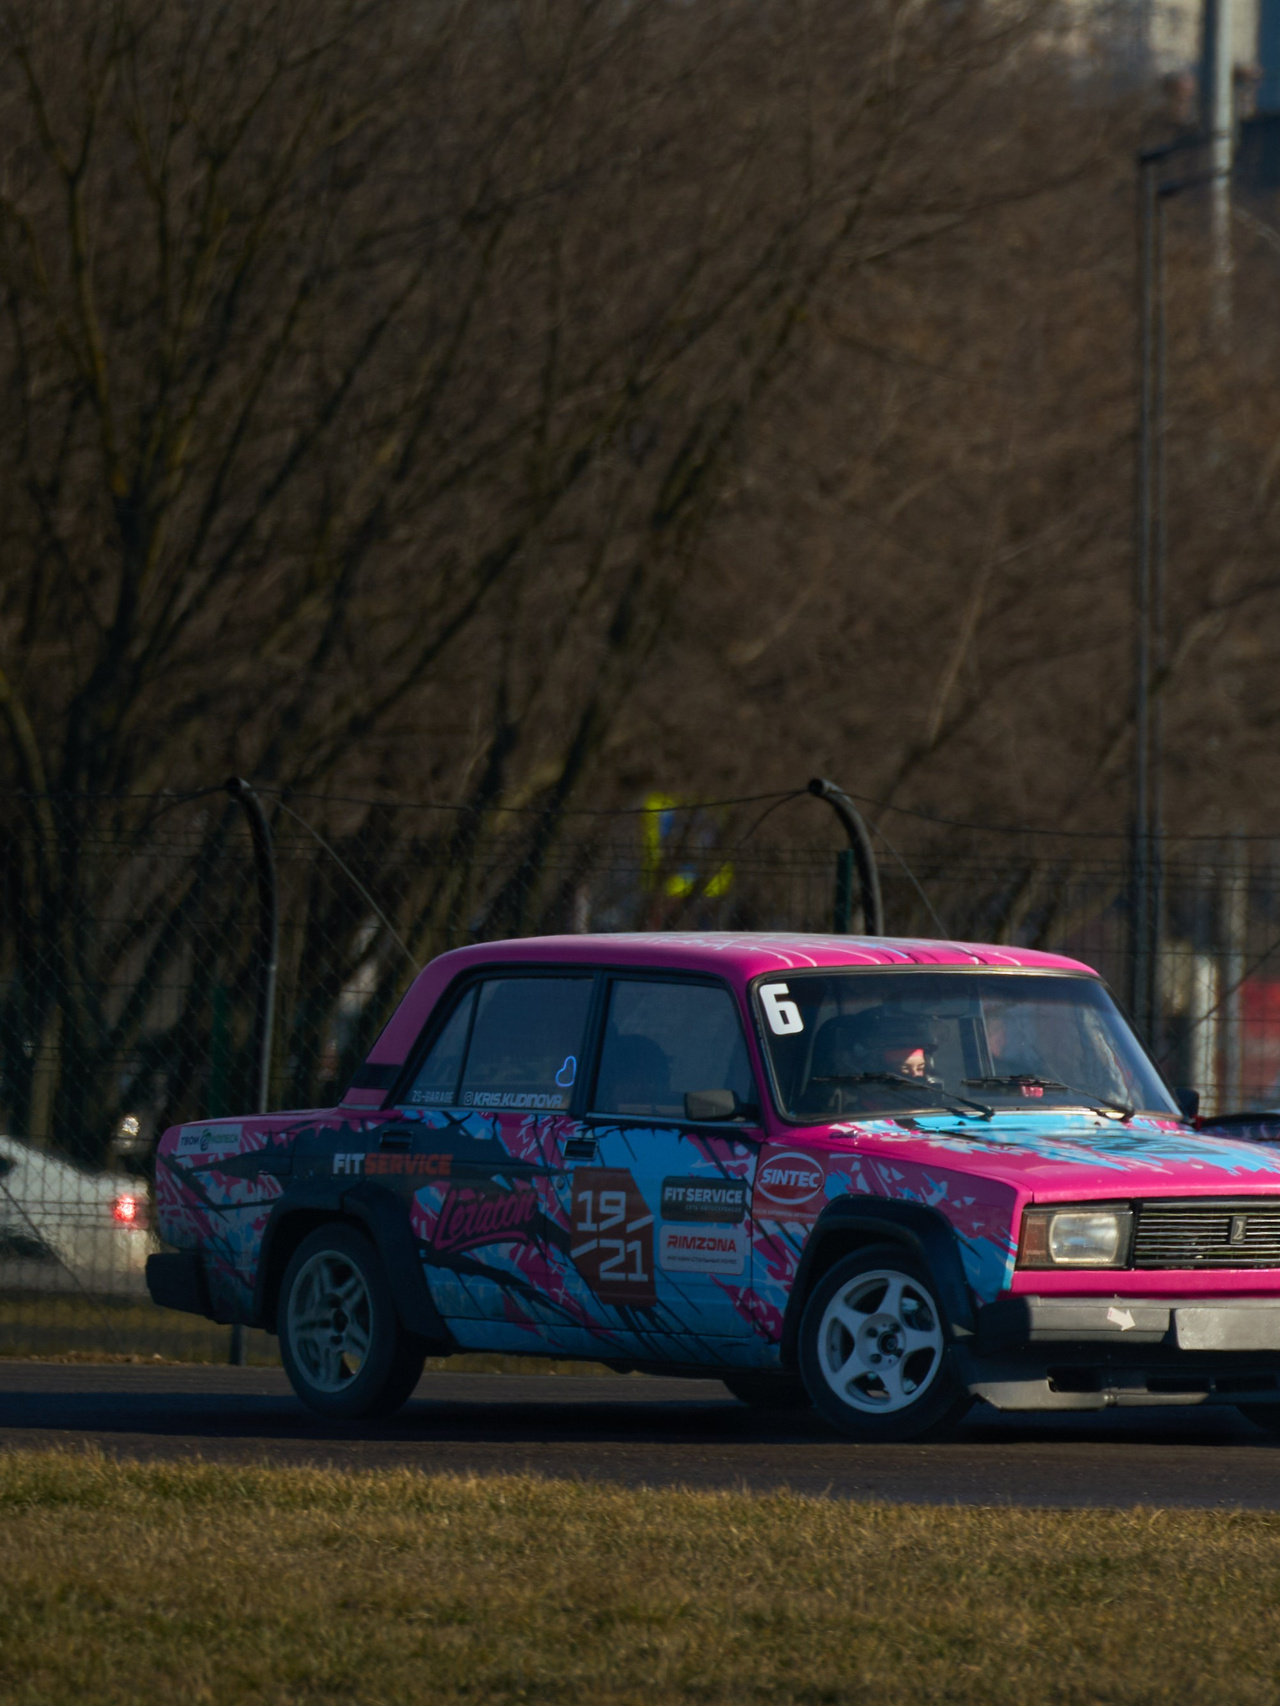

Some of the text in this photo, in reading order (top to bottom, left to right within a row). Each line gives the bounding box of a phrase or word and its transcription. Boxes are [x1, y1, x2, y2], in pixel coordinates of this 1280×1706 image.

[759, 983, 804, 1035] 6
[761, 1168, 820, 1188] SINTEC
[577, 1190, 626, 1232] 19
[599, 1238, 649, 1281] 21
[667, 1235, 737, 1252] RIMZONA
